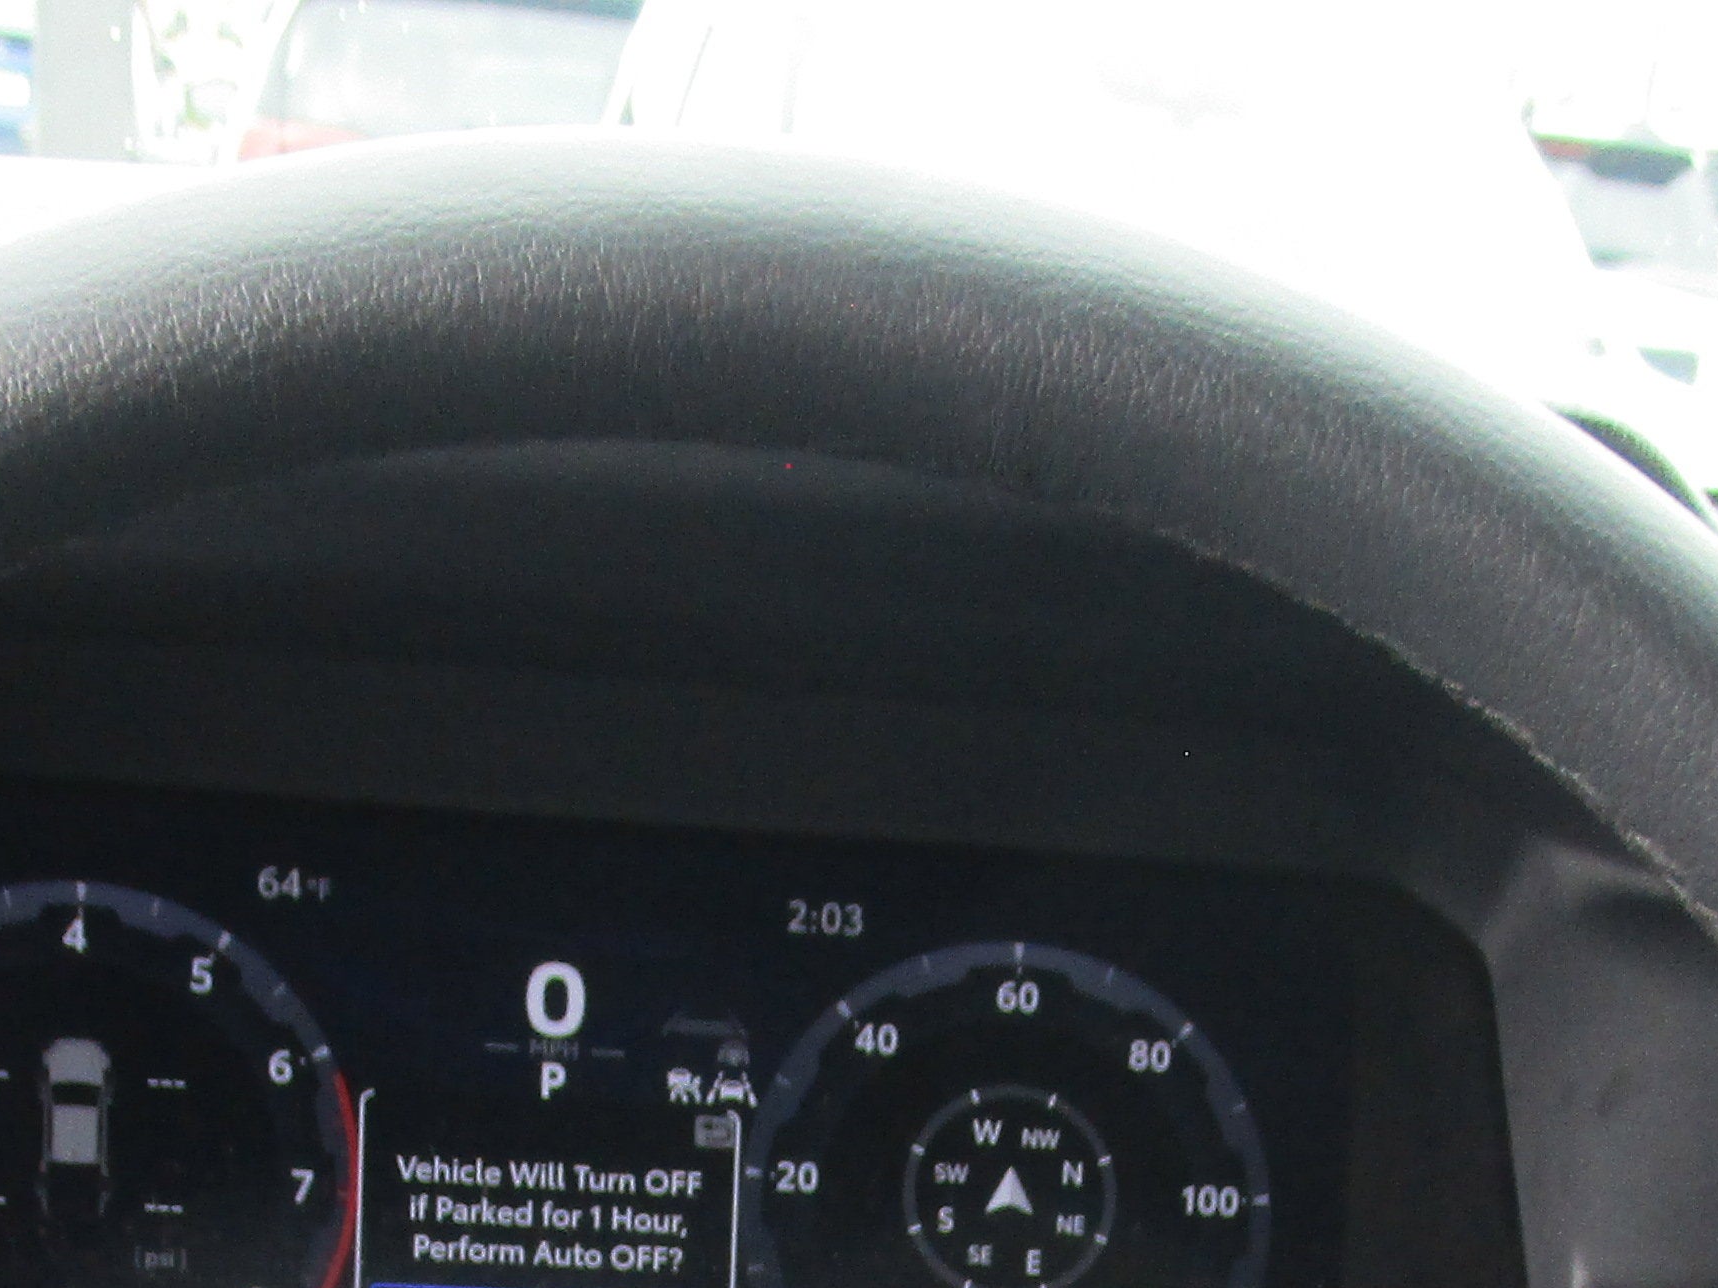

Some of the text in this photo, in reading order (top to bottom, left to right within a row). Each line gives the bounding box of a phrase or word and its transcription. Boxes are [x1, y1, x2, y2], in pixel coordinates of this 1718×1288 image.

[62, 915, 87, 953] 4
[786, 900, 864, 936] 2:03
[190, 956, 214, 994] 5
[526, 960, 585, 1039] 0
[995, 981, 1041, 1014] 60
[854, 1023, 899, 1056] 40
[1128, 1039, 1173, 1073] 80
[268, 1050, 294, 1084] 6
[540, 1062, 567, 1100] P
[973, 1117, 1003, 1146] W
[1021, 1127, 1061, 1150] NW
[291, 1167, 315, 1206] 7
[396, 1153, 703, 1198] Vehicle Will Turn OFF
[775, 1161, 819, 1195] 20
[934, 1160, 970, 1185] SW
[1060, 1159, 1084, 1187] N
[436, 1195, 533, 1228] Parked
[541, 1200, 583, 1230] for
[589, 1205, 602, 1231] 1
[611, 1205, 688, 1240] Hour,
[1182, 1184, 1242, 1218] 100
[937, 1205, 955, 1234] S
[1055, 1213, 1086, 1237] NE
[413, 1233, 683, 1274] Perform Auto OFF?
[967, 1244, 993, 1268] SE
[1025, 1248, 1042, 1277] E
